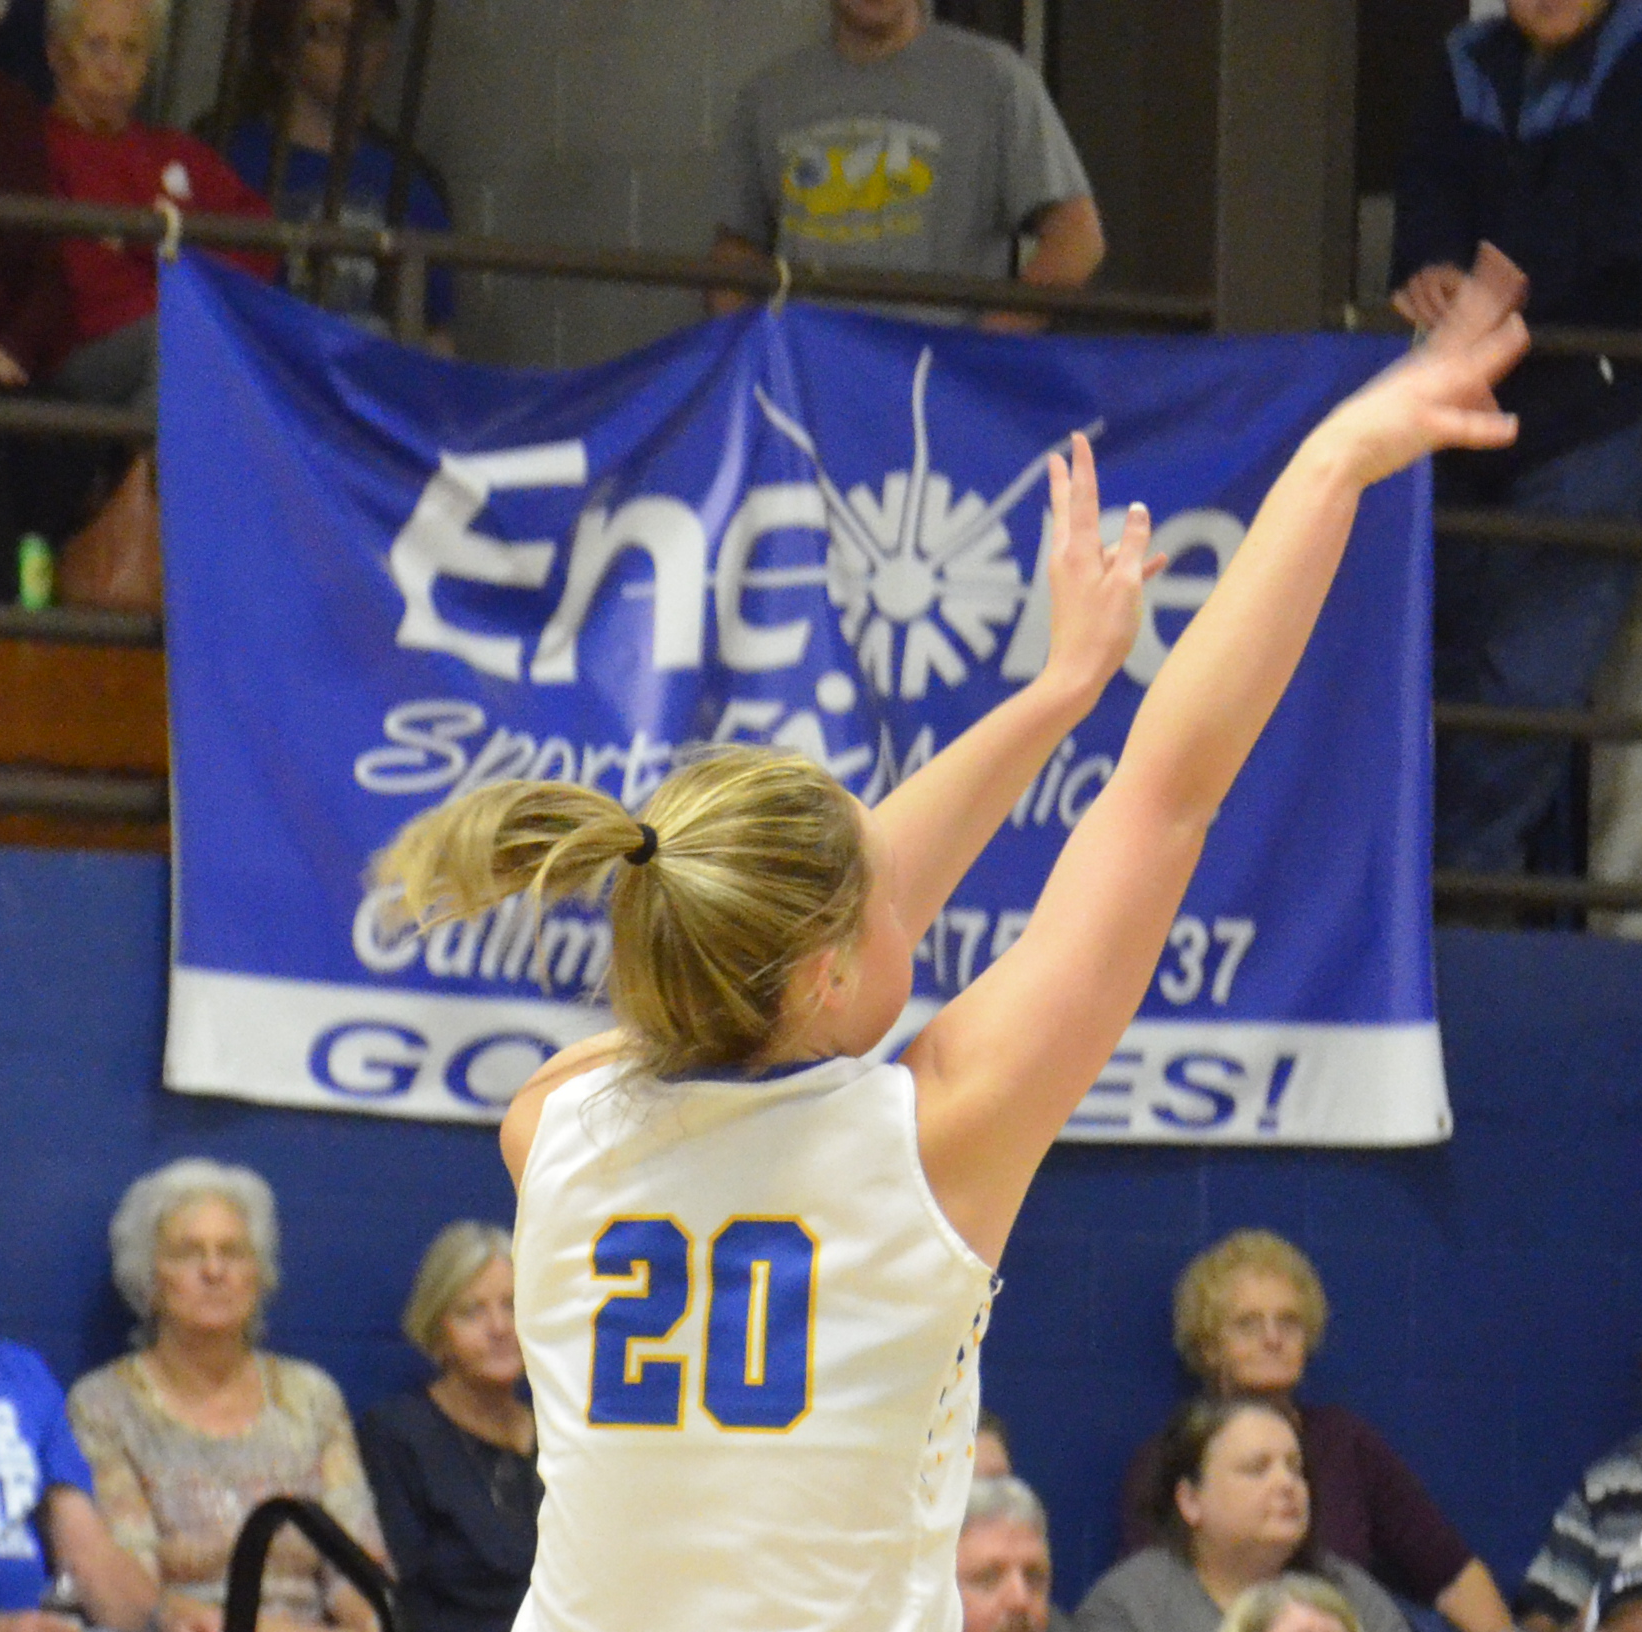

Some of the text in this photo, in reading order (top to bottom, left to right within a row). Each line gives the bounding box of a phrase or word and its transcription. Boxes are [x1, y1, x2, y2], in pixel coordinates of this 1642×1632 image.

[353, 698, 679, 812] Sport
[352, 884, 613, 968] Cullm
[586, 1212, 820, 1434] 20
